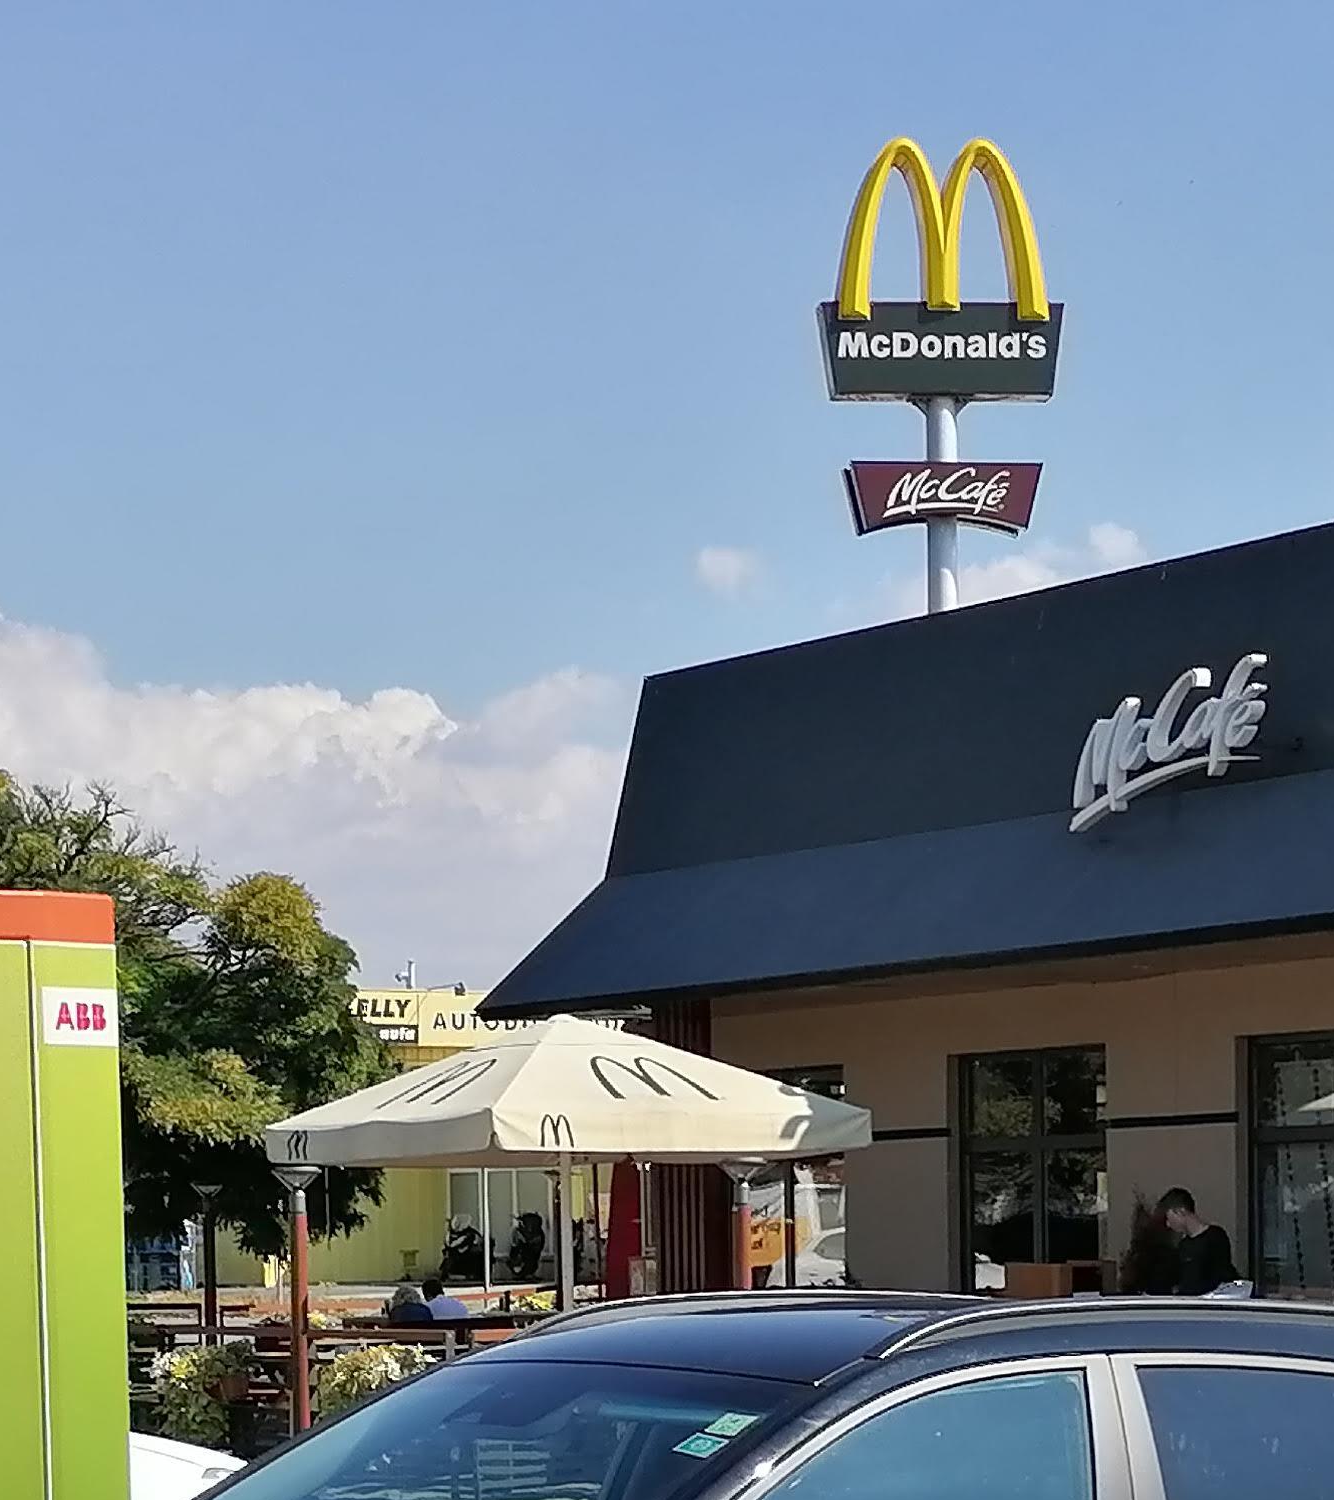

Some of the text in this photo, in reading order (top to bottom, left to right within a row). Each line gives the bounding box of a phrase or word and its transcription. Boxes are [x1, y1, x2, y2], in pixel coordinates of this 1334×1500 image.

[836, 331, 1047, 360] McDonald's
[883, 469, 1009, 517] McCafé
[1071, 653, 1267, 814] McCafé
[55, 1001, 107, 1031] ABB
